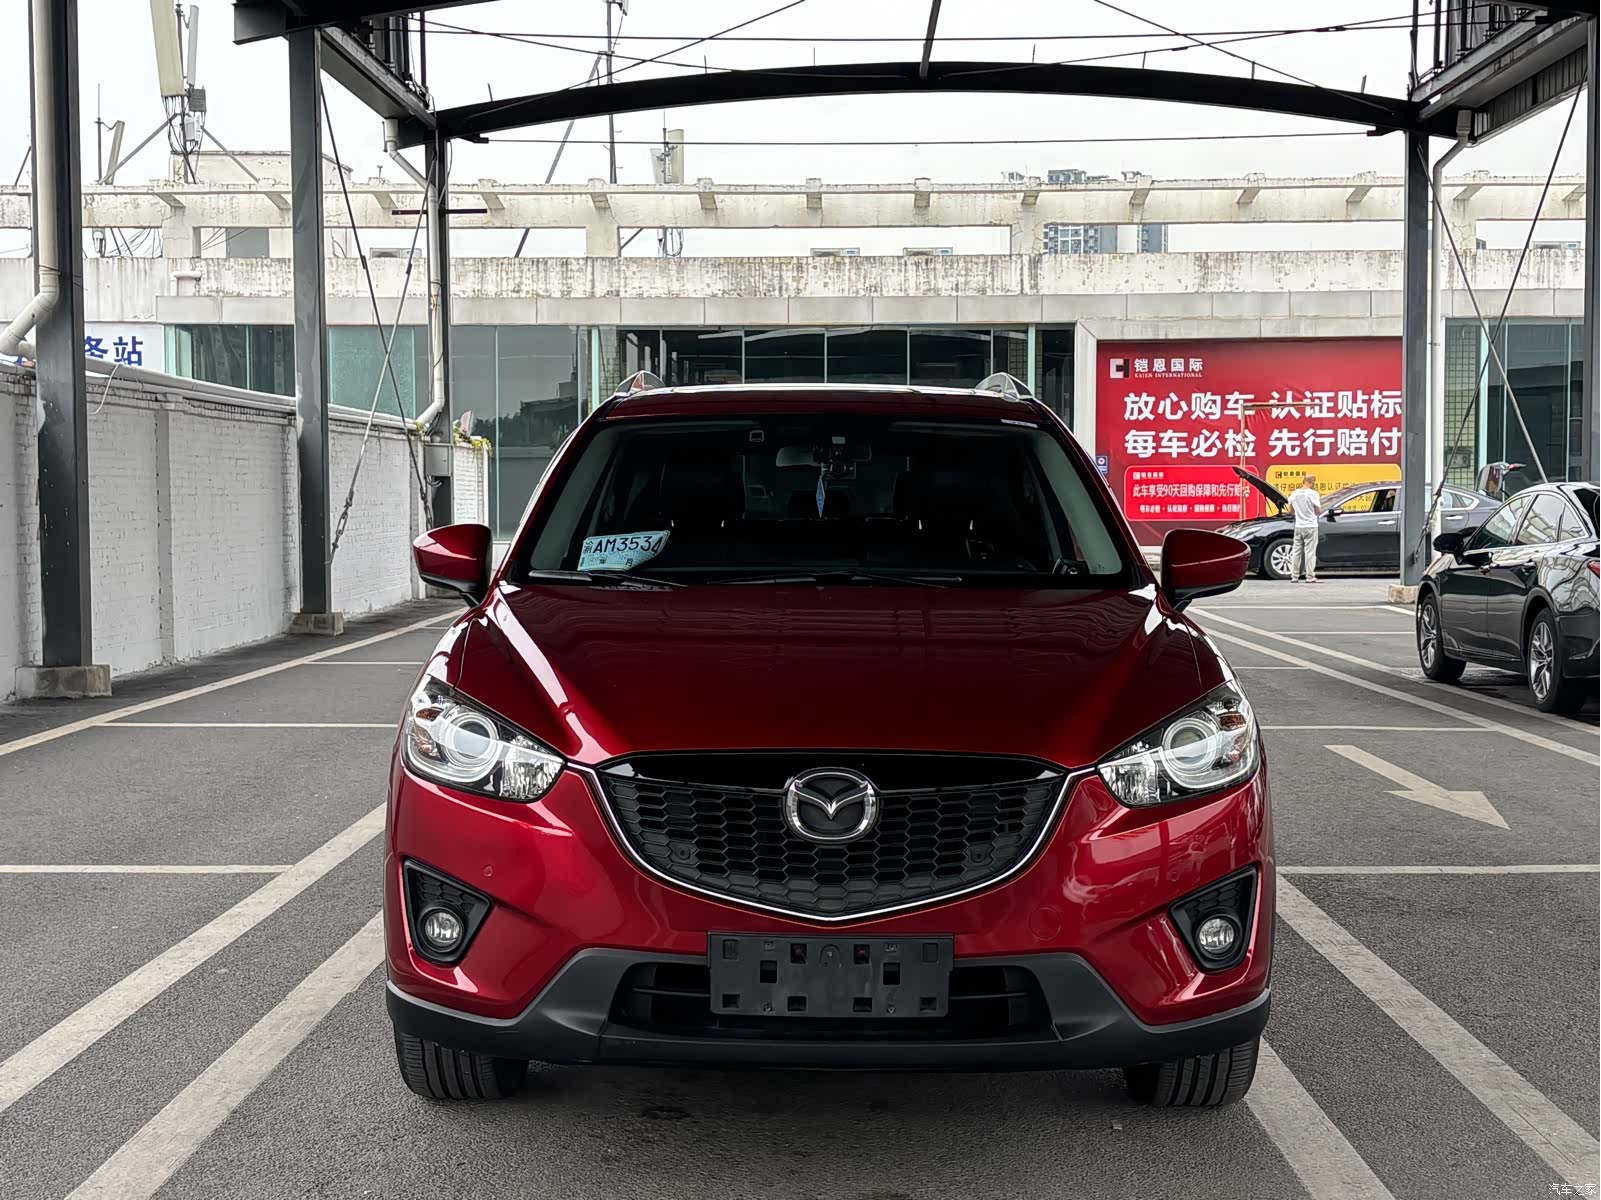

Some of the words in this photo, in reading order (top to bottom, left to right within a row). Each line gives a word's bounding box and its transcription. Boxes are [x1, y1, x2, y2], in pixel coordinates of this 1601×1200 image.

[1134, 358, 1203, 372] 铠恩国际
[1123, 391, 1255, 421] 放心购车
[1270, 390, 1402, 420] 认证贴标
[1124, 429, 1256, 458] 每车必检
[1268, 427, 1402, 457] 先行赔付
